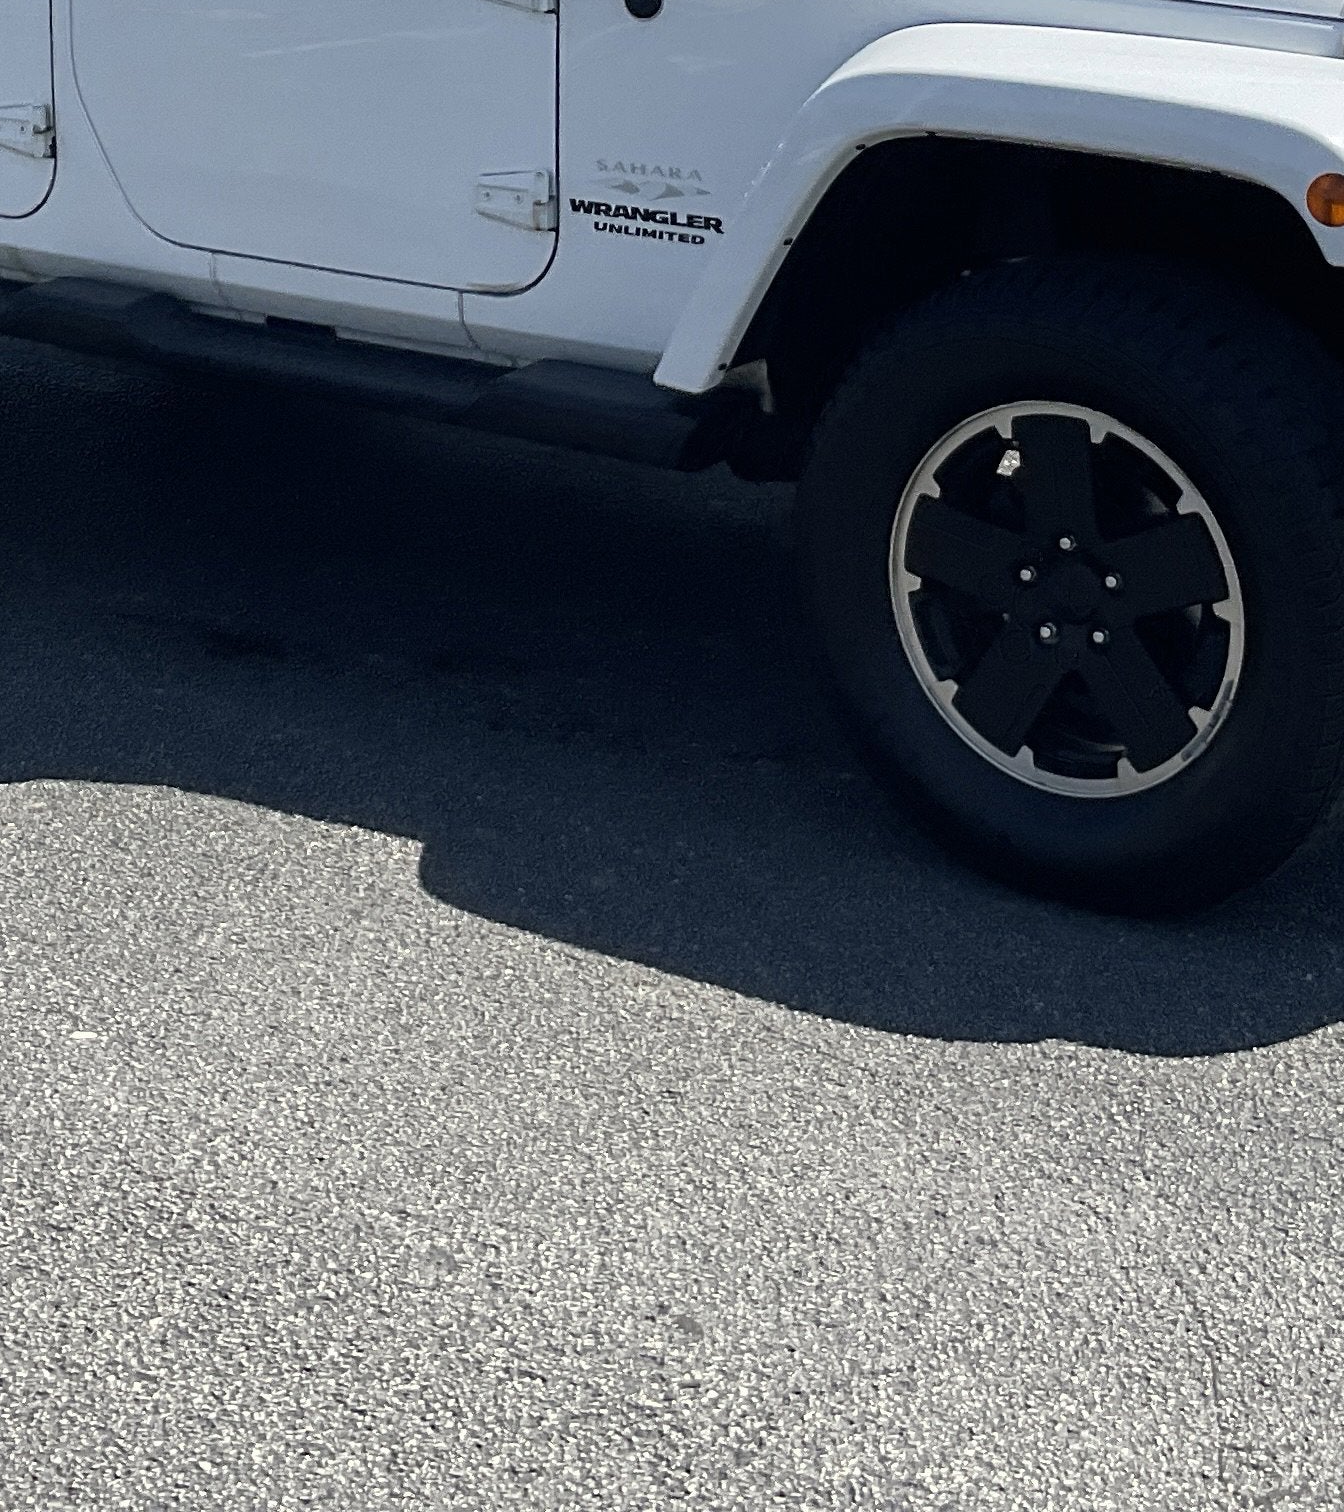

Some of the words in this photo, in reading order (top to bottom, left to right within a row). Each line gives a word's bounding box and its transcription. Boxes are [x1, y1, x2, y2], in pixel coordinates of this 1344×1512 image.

[595, 158, 703, 182] SAHARA
[568, 198, 725, 235] WRANGLER
[593, 221, 706, 245] UNLIMITED
